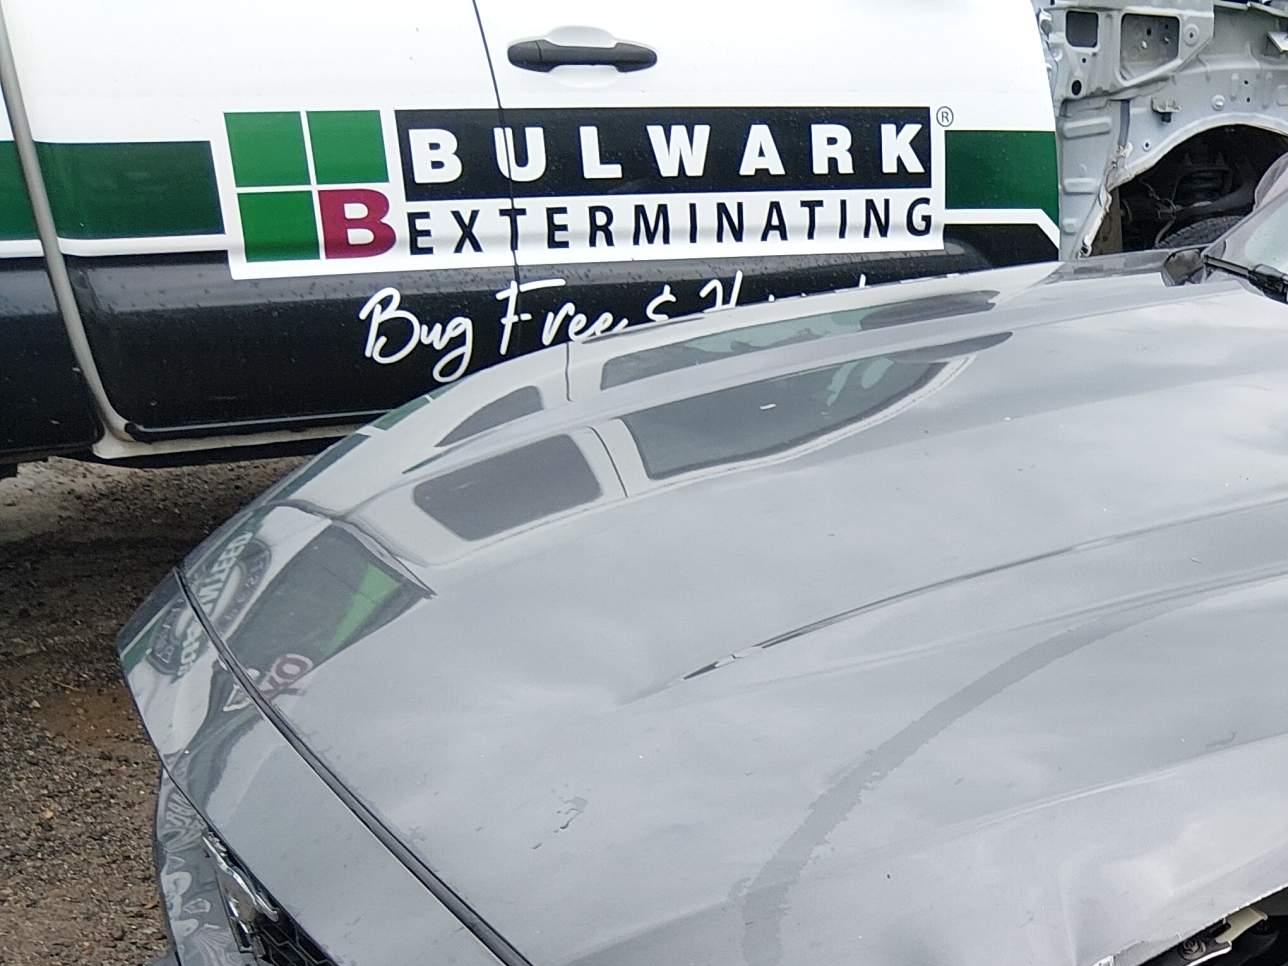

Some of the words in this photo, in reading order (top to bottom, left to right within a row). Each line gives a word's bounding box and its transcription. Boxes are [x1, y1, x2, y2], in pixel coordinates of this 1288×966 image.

[408, 123, 926, 184] BULWARK
[406, 197, 933, 256] EXTERMINATING
[358, 286, 474, 384] Bug
